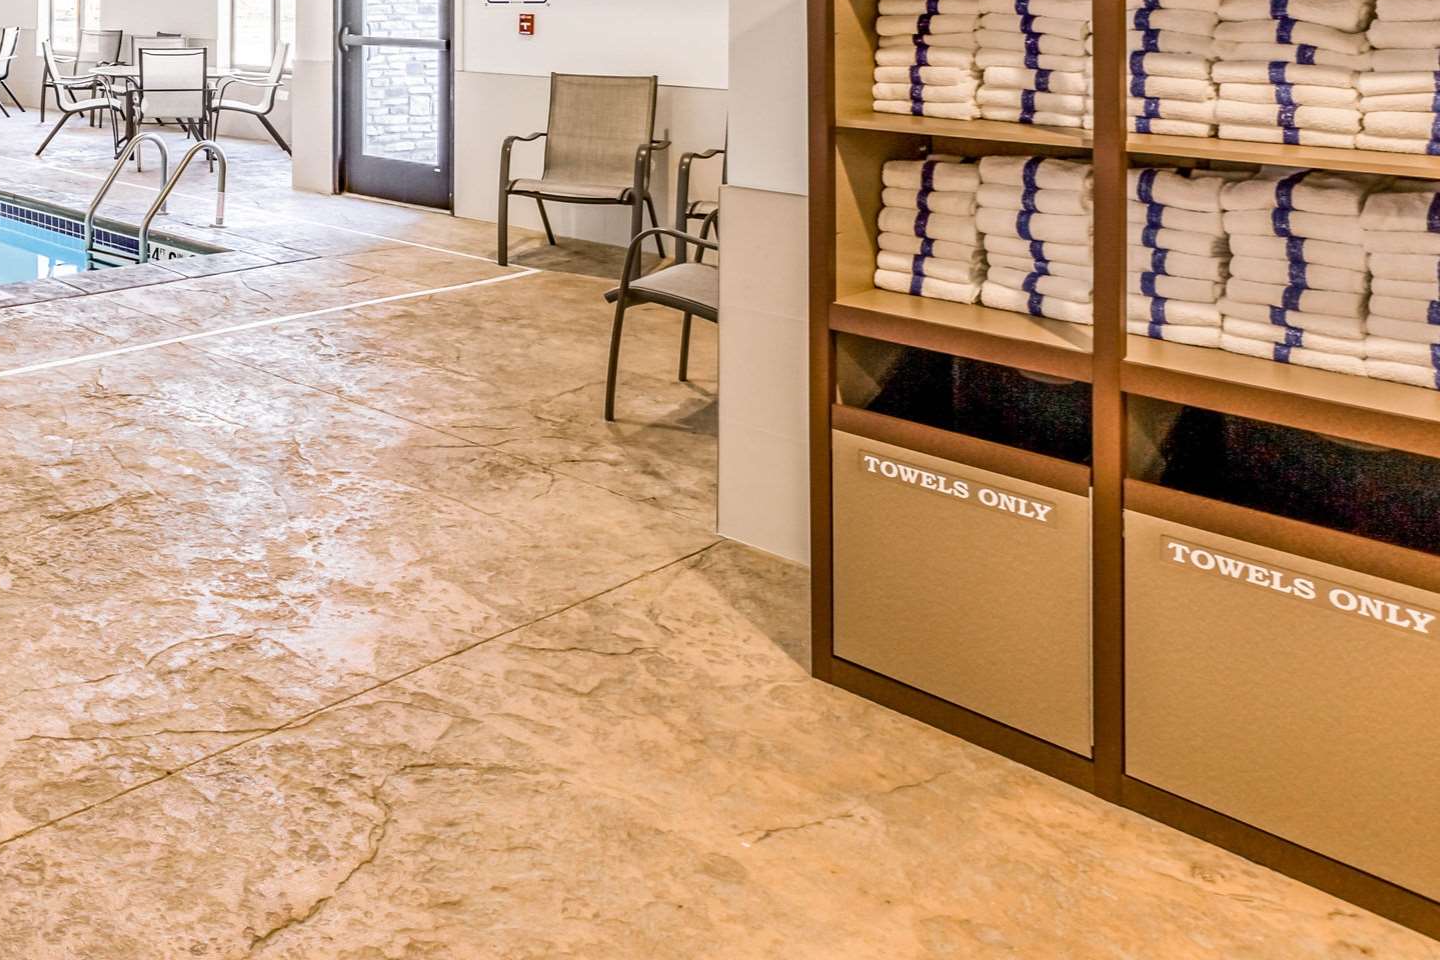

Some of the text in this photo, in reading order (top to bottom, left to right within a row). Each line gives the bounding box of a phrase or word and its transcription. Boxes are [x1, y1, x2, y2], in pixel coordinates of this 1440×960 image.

[864, 455, 1052, 522] TOWELS ONLY
[1168, 542, 1435, 634] TOWELS ONLY
